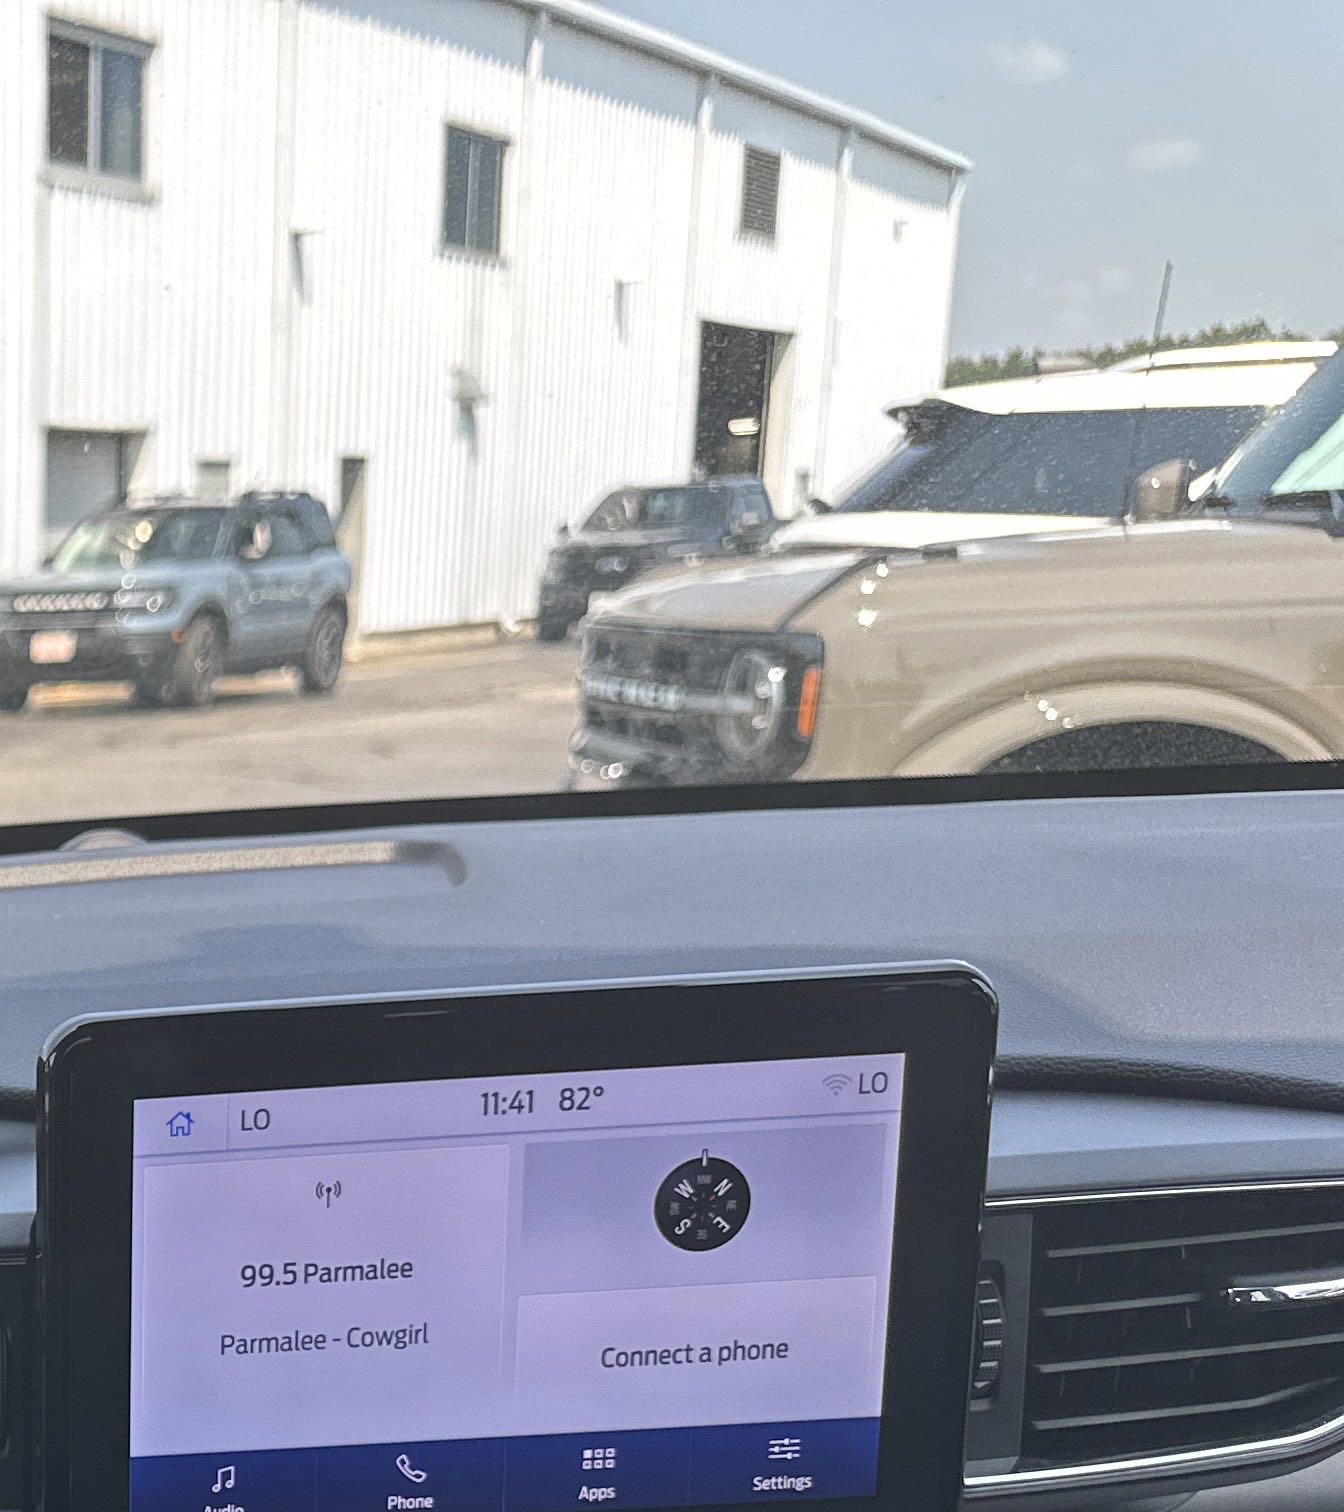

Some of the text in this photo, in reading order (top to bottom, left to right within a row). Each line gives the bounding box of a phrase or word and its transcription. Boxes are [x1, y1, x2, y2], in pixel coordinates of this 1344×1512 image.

[858, 1072, 888, 1094] LO
[480, 1086, 605, 1116] 11:41 82°
[240, 1108, 271, 1131] LO
[674, 1179, 694, 1199] W
[713, 1178, 734, 1197] N
[674, 1218, 692, 1235] S
[712, 1216, 731, 1234] E
[240, 1258, 414, 1288] 99.5 Parmalee
[220, 1330, 327, 1356] Parmalee
[346, 1322, 429, 1350] Cowgirl
[600, 1339, 790, 1368] Connect a phone
[578, 1484, 617, 1502] Apps
[752, 1473, 813, 1493] Settings
[386, 1494, 434, 1512] Phone
